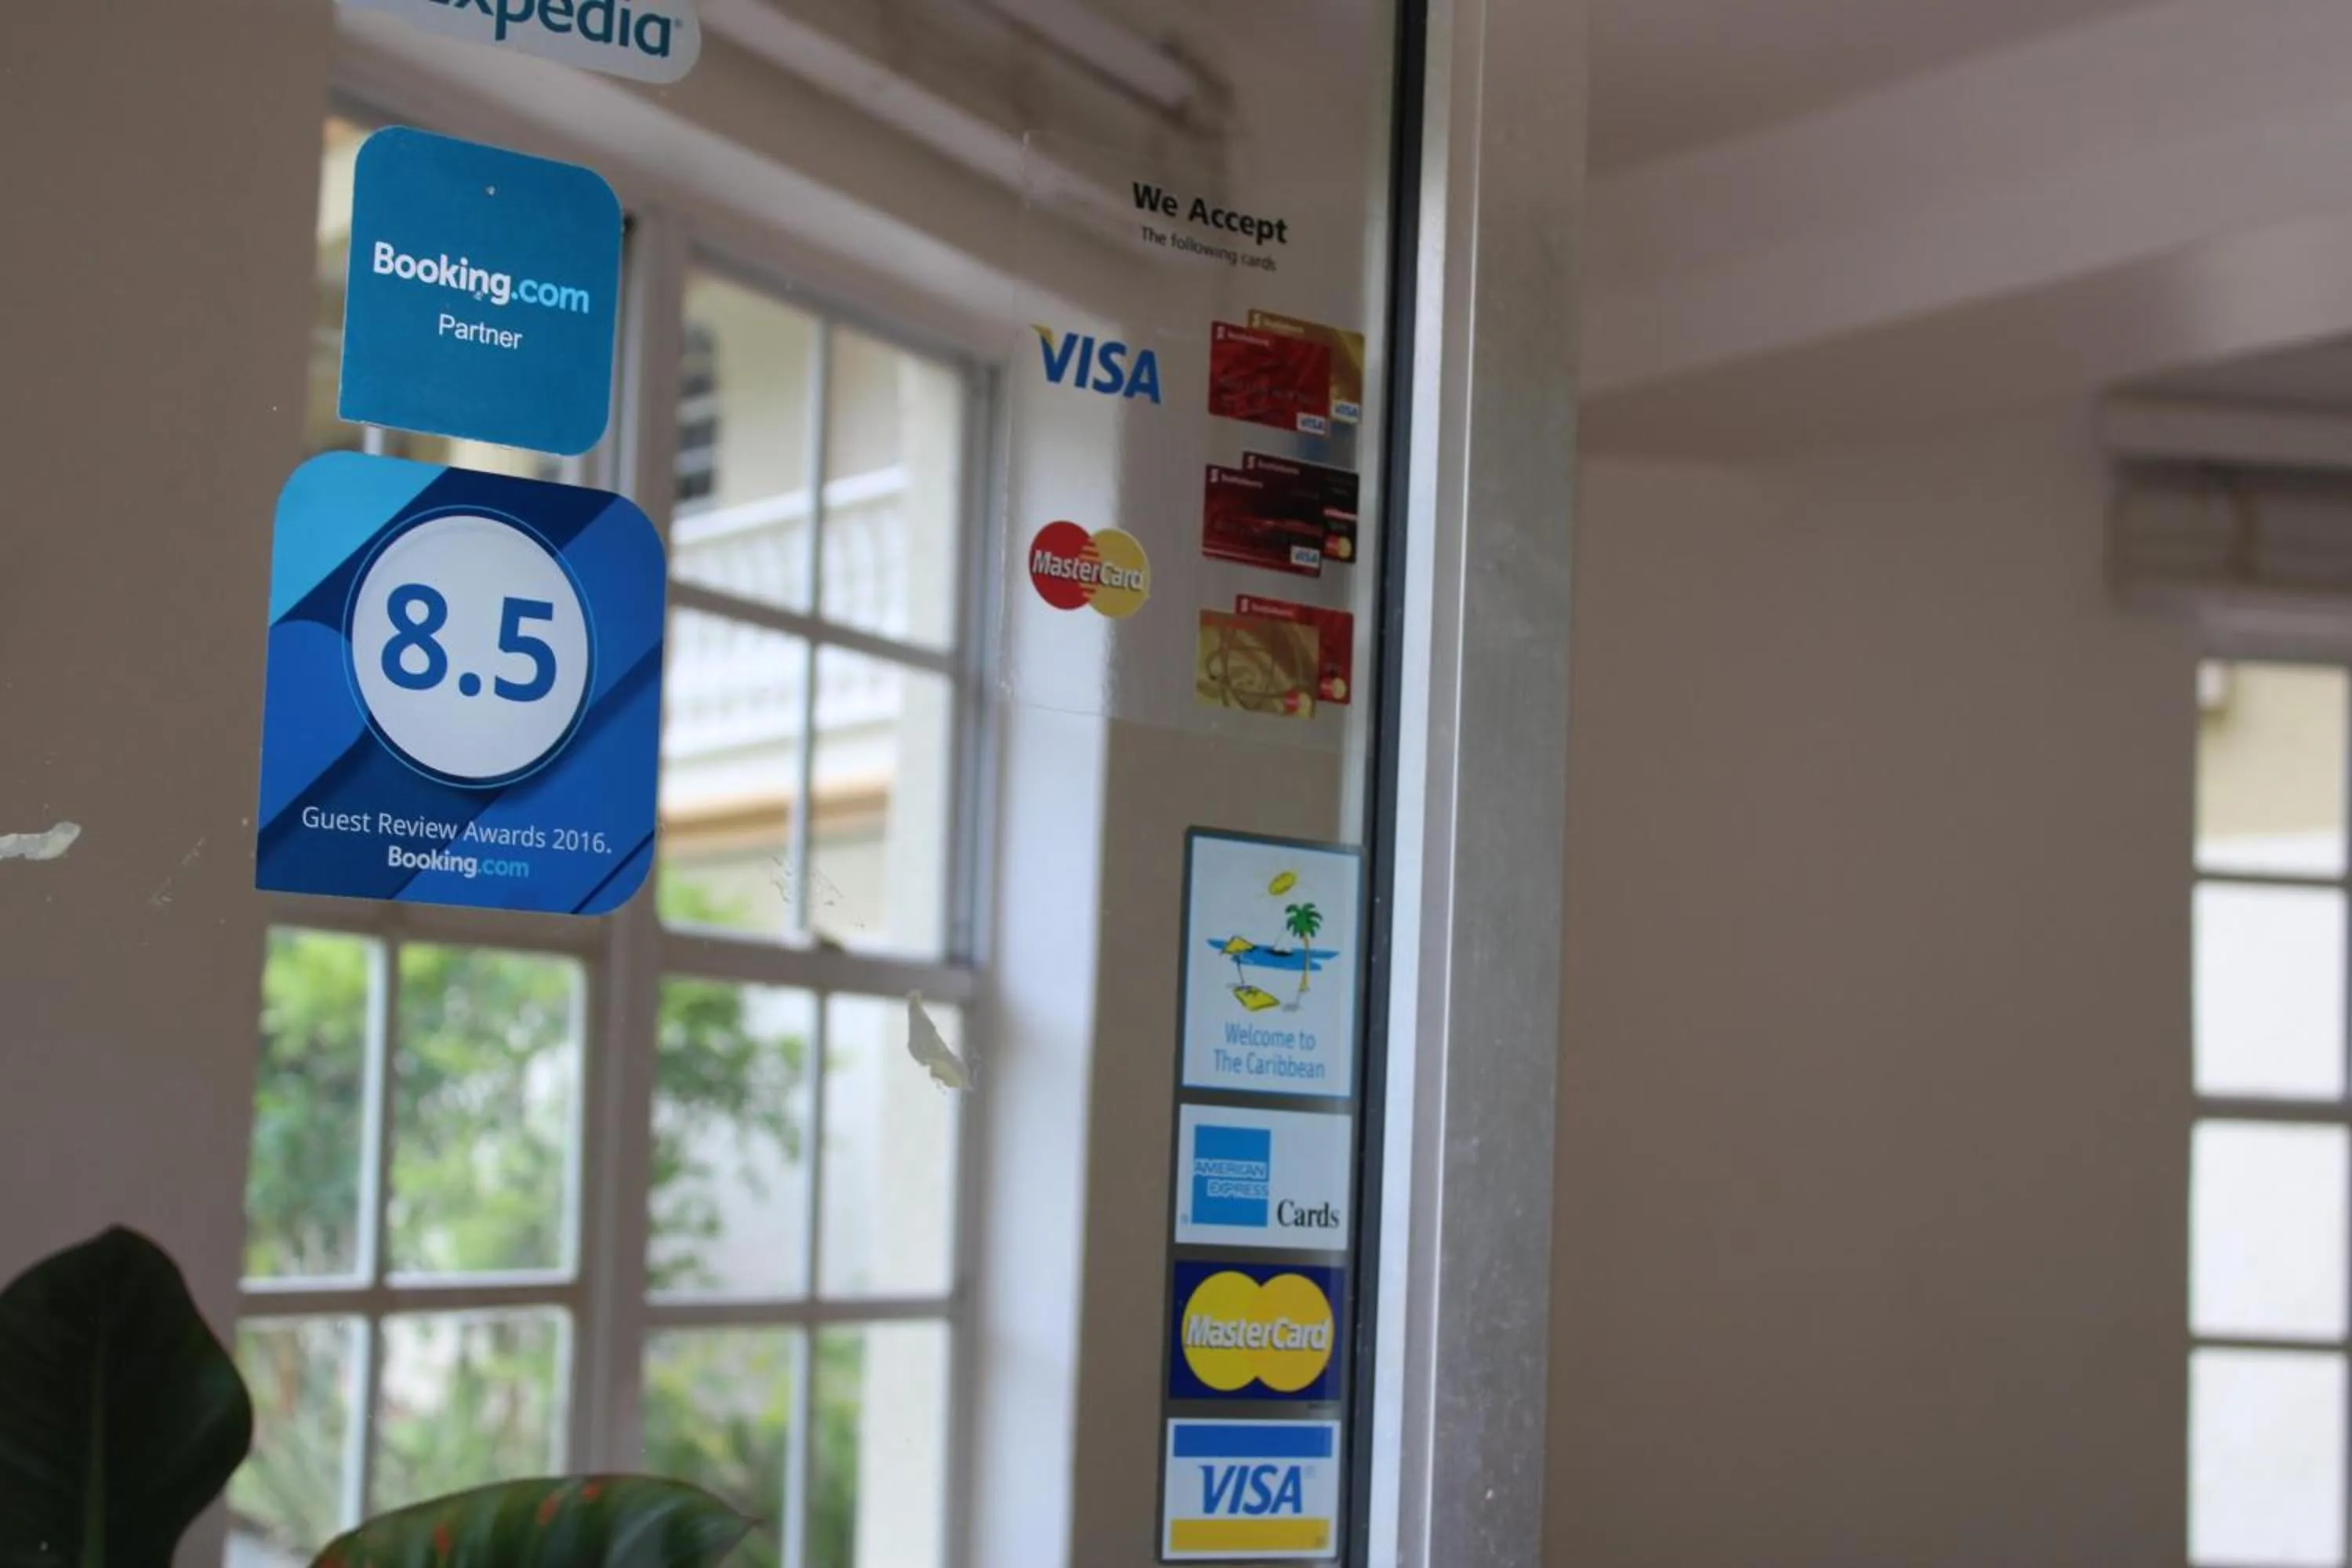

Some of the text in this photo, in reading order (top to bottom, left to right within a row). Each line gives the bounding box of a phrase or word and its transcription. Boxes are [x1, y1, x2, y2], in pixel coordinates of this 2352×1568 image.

[428, 0, 671, 59] pedia
[1133, 181, 1288, 246] We Accept
[1141, 226, 1167, 247] The
[1170, 231, 1238, 267] following
[373, 241, 589, 314] Booking.com
[437, 313, 523, 350] Partner
[1031, 324, 1161, 405] VISA
[1032, 550, 1145, 590] MasterCard
[381, 583, 557, 702] 8.5
[302, 806, 613, 854] Guest Review Awards 2016.
[387, 845, 530, 879] Booking.com
[1224, 1021, 1317, 1051] Welcome to
[1213, 1048, 1326, 1079] The Caribbean
[1193, 1160, 1265, 1177] AMERICAN
[1277, 1198, 1339, 1229] Cards
[1185, 1314, 1331, 1350] MasterCard
[1199, 1464, 1303, 1515] VISA
